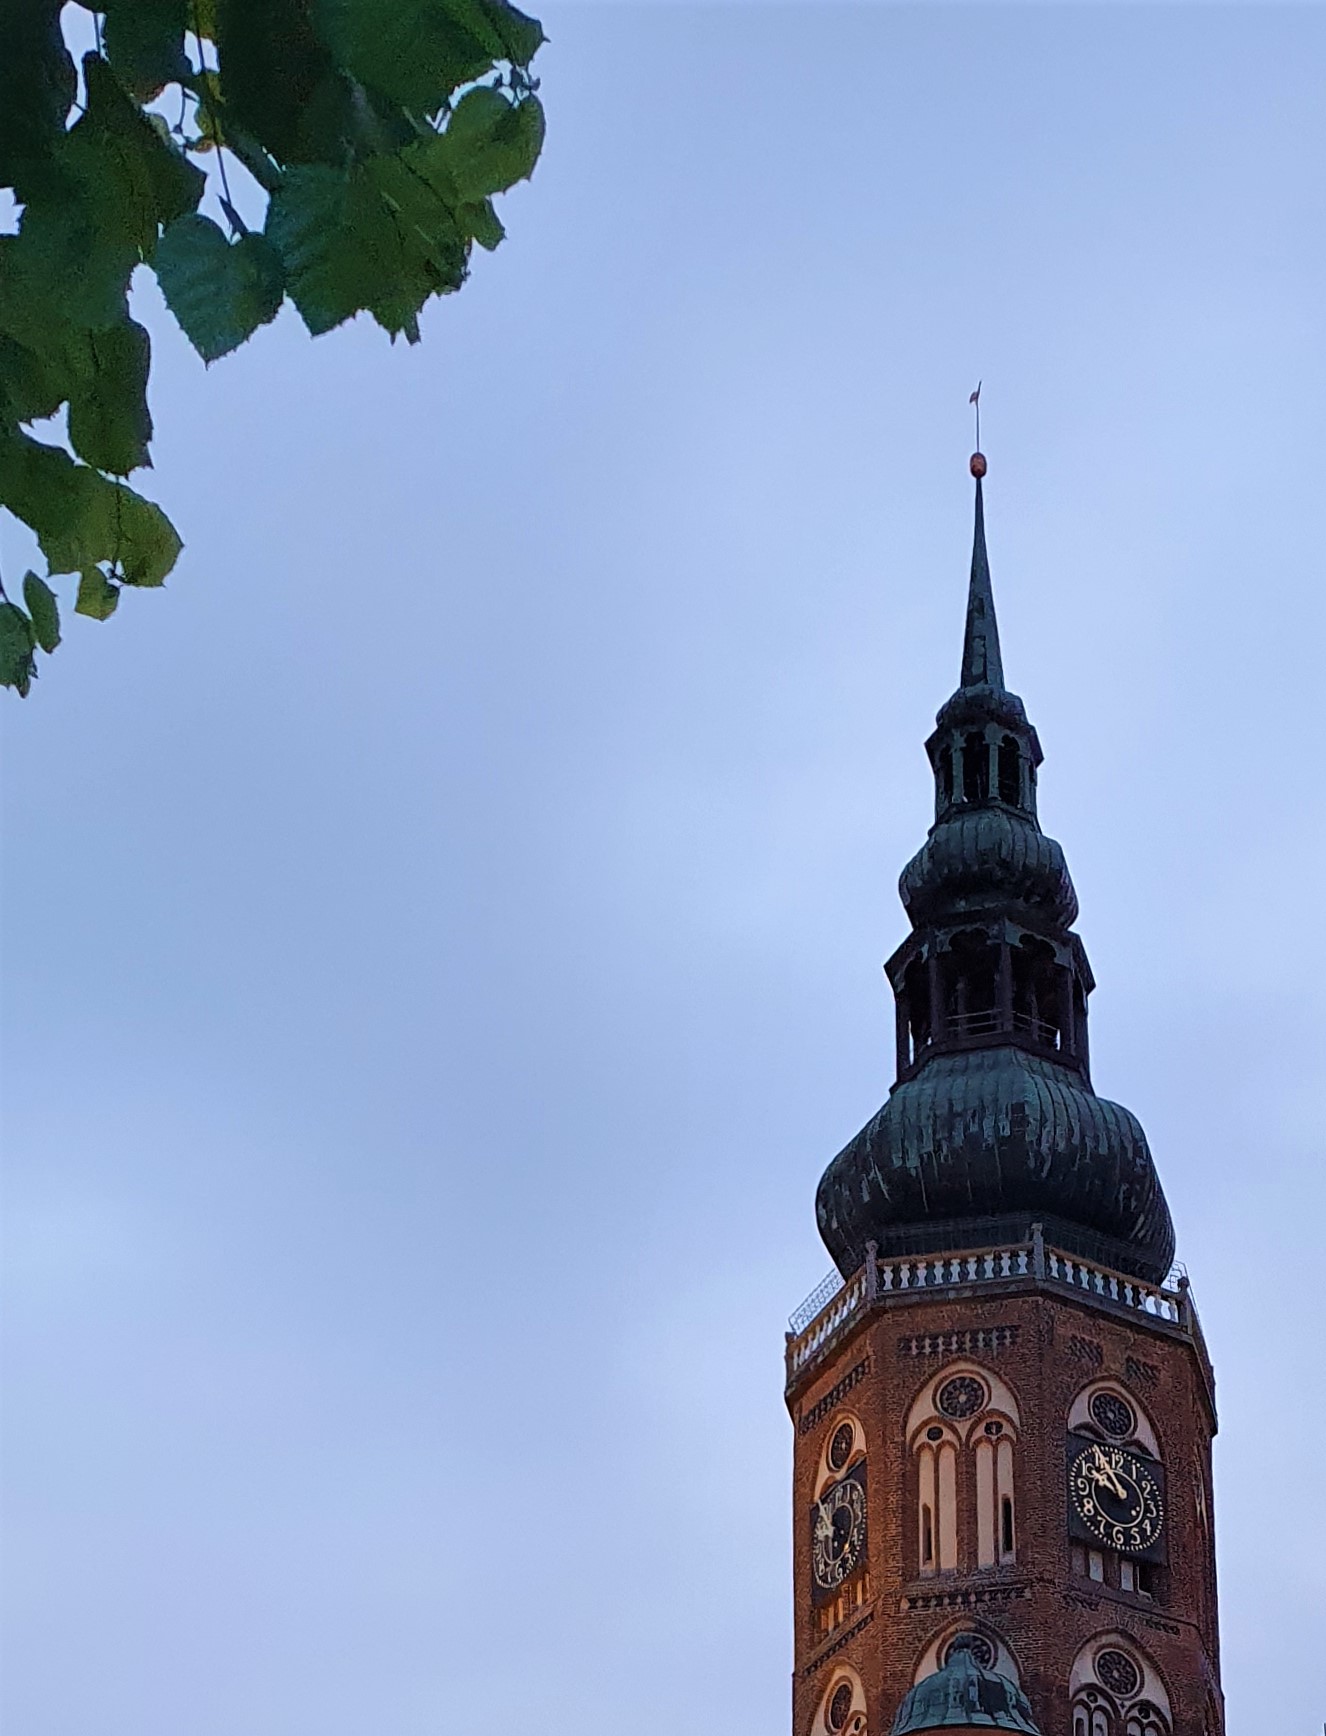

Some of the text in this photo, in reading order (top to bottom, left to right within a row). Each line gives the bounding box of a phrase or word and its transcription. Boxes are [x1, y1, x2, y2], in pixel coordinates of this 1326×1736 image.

[1081, 1459, 1096, 1478] 10
[1111, 1453, 1124, 1472] 12
[1132, 1464, 1137, 1480] 1
[1077, 1477, 1090, 1496] 9
[1141, 1480, 1151, 1498] 2
[1083, 1497, 1095, 1516] 8
[1146, 1500, 1157, 1518] 3
[1097, 1516, 1106, 1535] 7
[1141, 1519, 1151, 1536] 4
[1112, 1526, 1124, 1545] 6
[1130, 1527, 1141, 1545] 5
